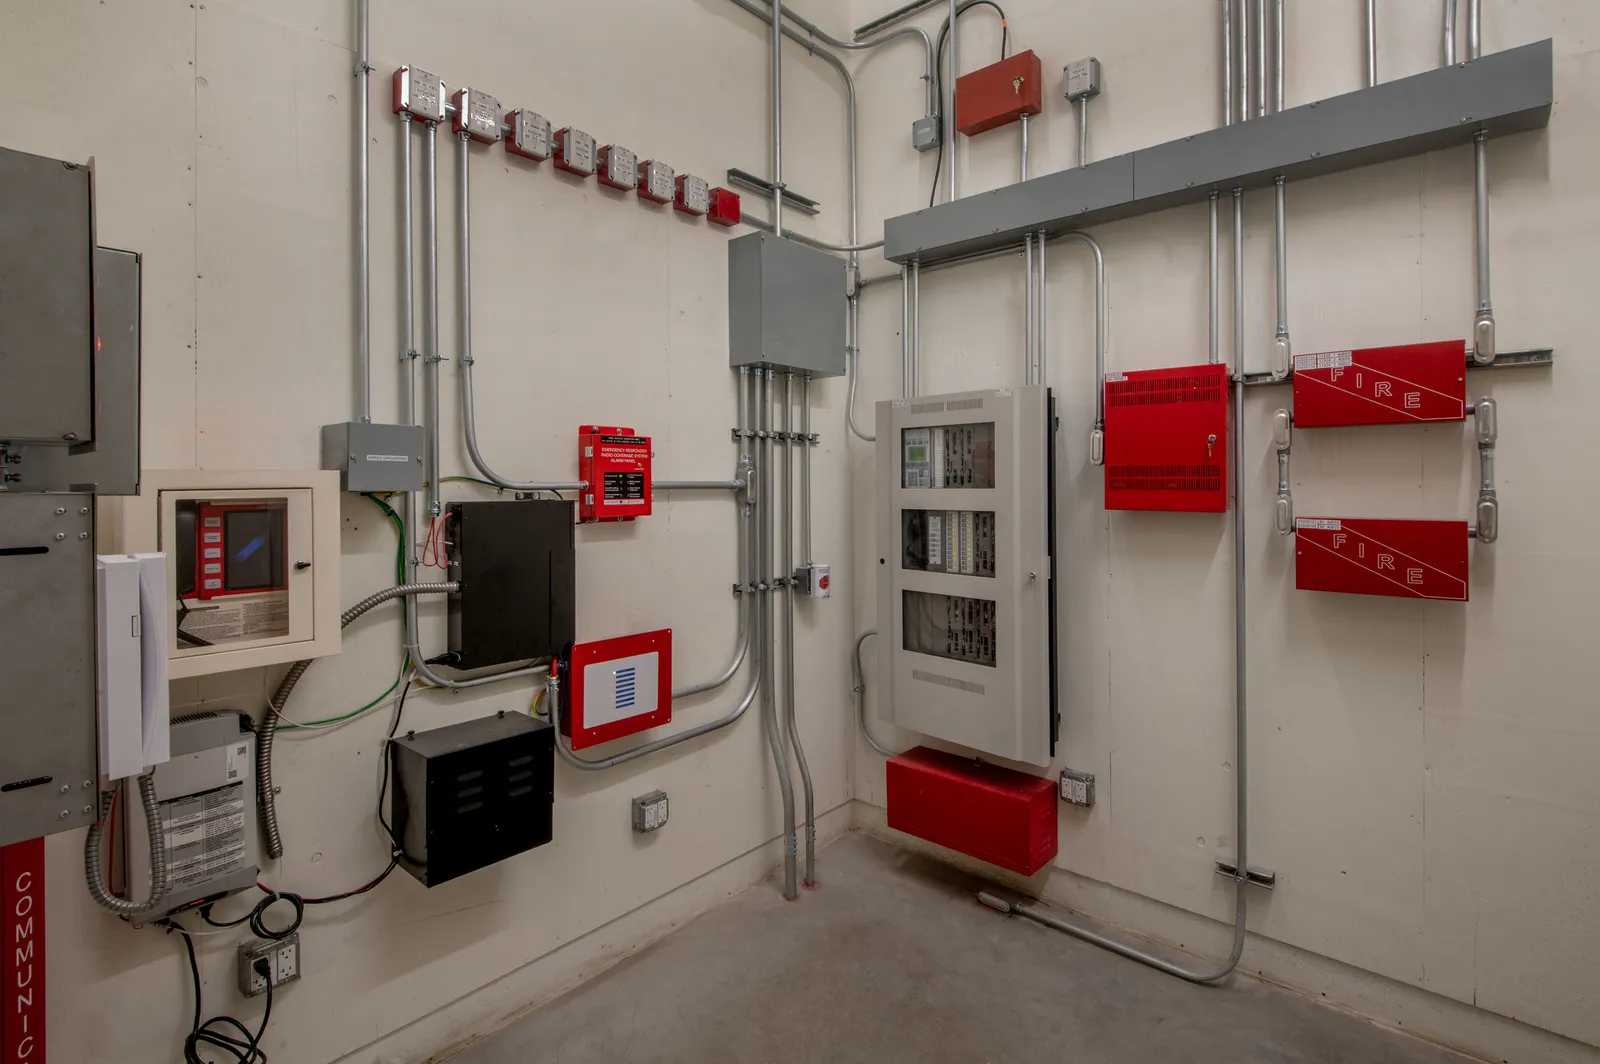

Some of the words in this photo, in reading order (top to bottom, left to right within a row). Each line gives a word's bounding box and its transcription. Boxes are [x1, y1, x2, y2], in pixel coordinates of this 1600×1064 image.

[1331, 366, 1420, 409] FIRE
[1333, 533, 1423, 584] FIRE
[15, 871, 34, 1064] COMMUNIC
